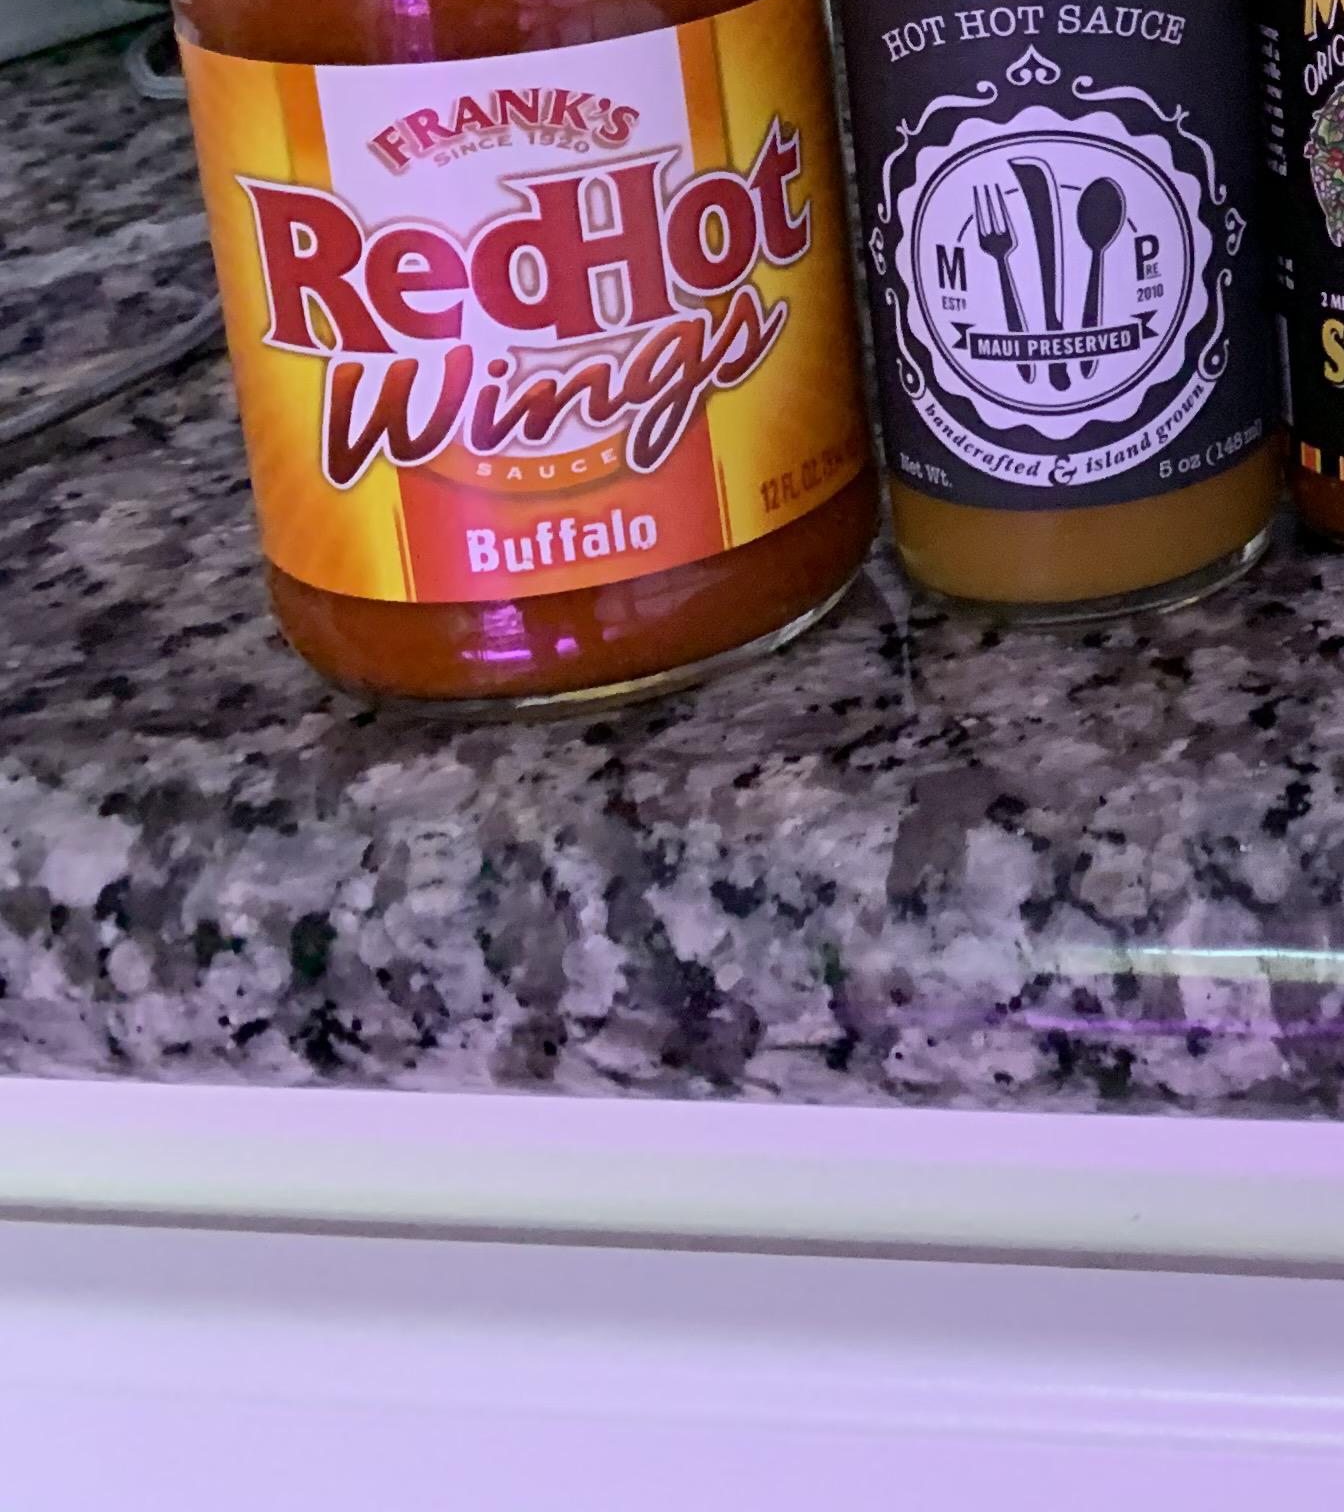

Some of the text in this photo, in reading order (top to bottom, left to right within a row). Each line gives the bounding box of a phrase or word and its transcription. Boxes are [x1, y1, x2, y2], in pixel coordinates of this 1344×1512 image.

[882, 4, 1186, 62] HOT HOT SAUCE
[369, 87, 640, 174] FRANK'S
[433, 133, 591, 168] SINCE 1920
[238, 118, 810, 355] RedHot
[936, 244, 967, 291] M
[1136, 283, 1164, 302] 2010
[977, 330, 1131, 357] MAUI PRESERVED
[325, 286, 788, 488] Wings
[925, 383, 1204, 486] handcrafted & island grown
[476, 447, 619, 480] SAUCE
[900, 452, 923, 478] Net
[1159, 459, 1173, 478] 5
[1178, 454, 1201, 473] oz
[466, 508, 659, 573] Buffalo
